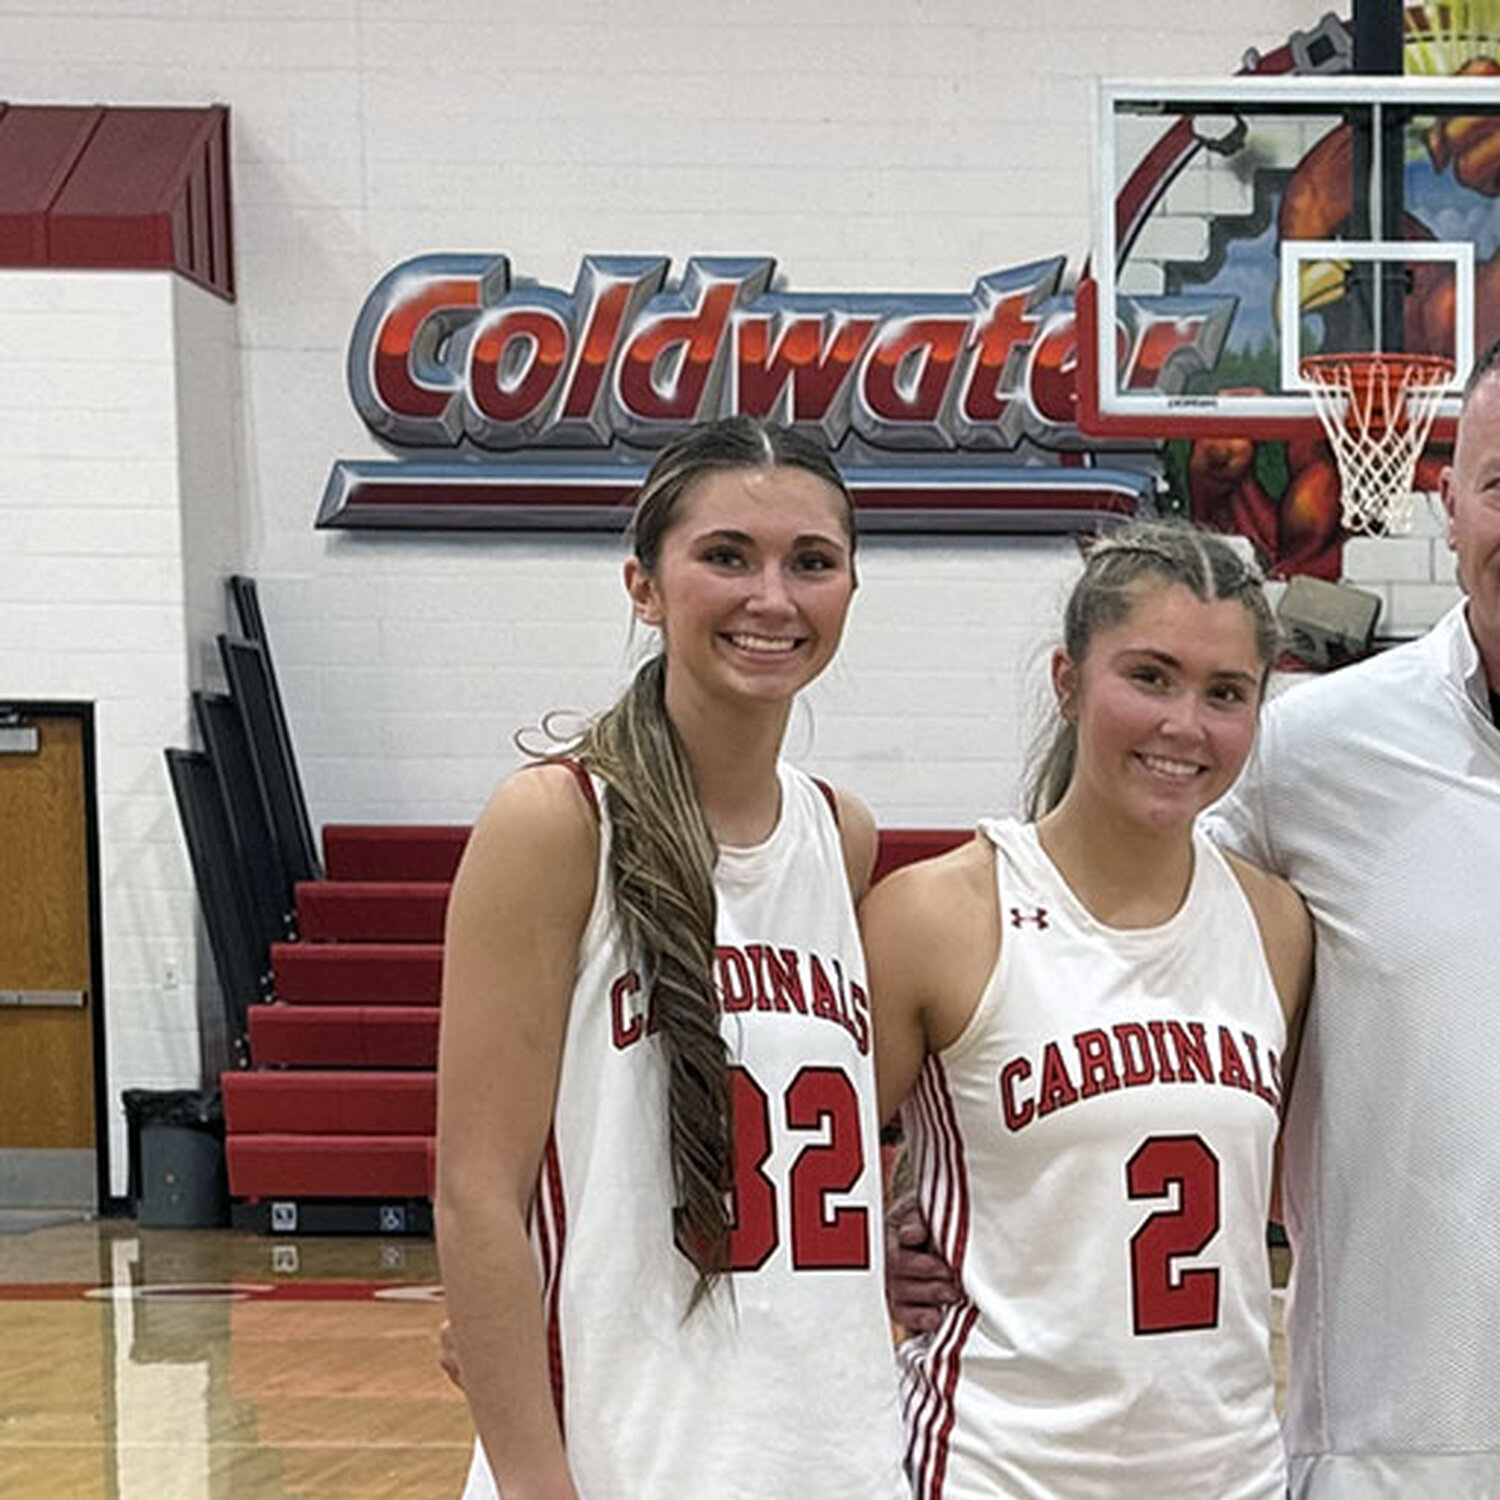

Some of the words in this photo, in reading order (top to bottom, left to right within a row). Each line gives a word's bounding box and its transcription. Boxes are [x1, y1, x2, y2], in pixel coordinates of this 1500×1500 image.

[346, 252, 1238, 452] Coldwater
[610, 944, 869, 1056] CDINALS
[1126, 1134, 1220, 1335] 2
